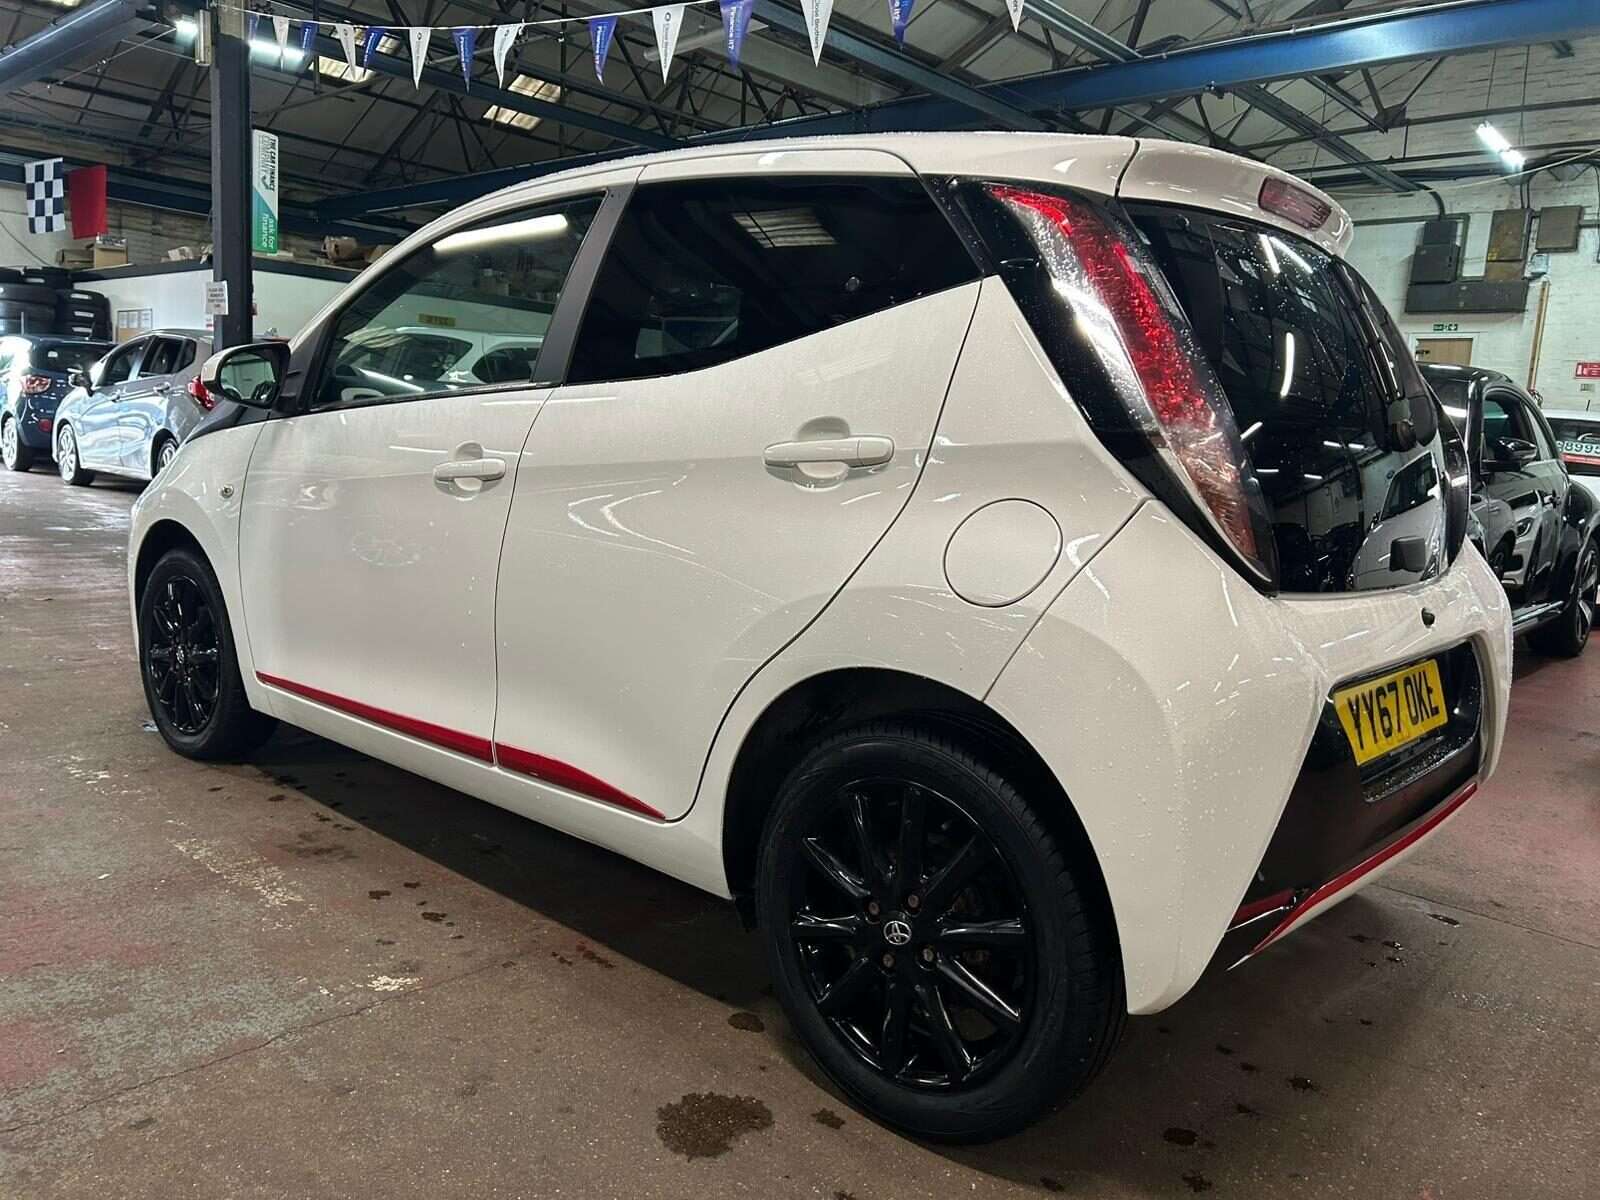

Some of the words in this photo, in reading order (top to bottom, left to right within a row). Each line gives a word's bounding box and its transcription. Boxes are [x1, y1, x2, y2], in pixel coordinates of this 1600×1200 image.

[268, 165, 276, 192] FINANCE
[1347, 681, 1402, 750] YY67
[1403, 670, 1440, 725] OKE
